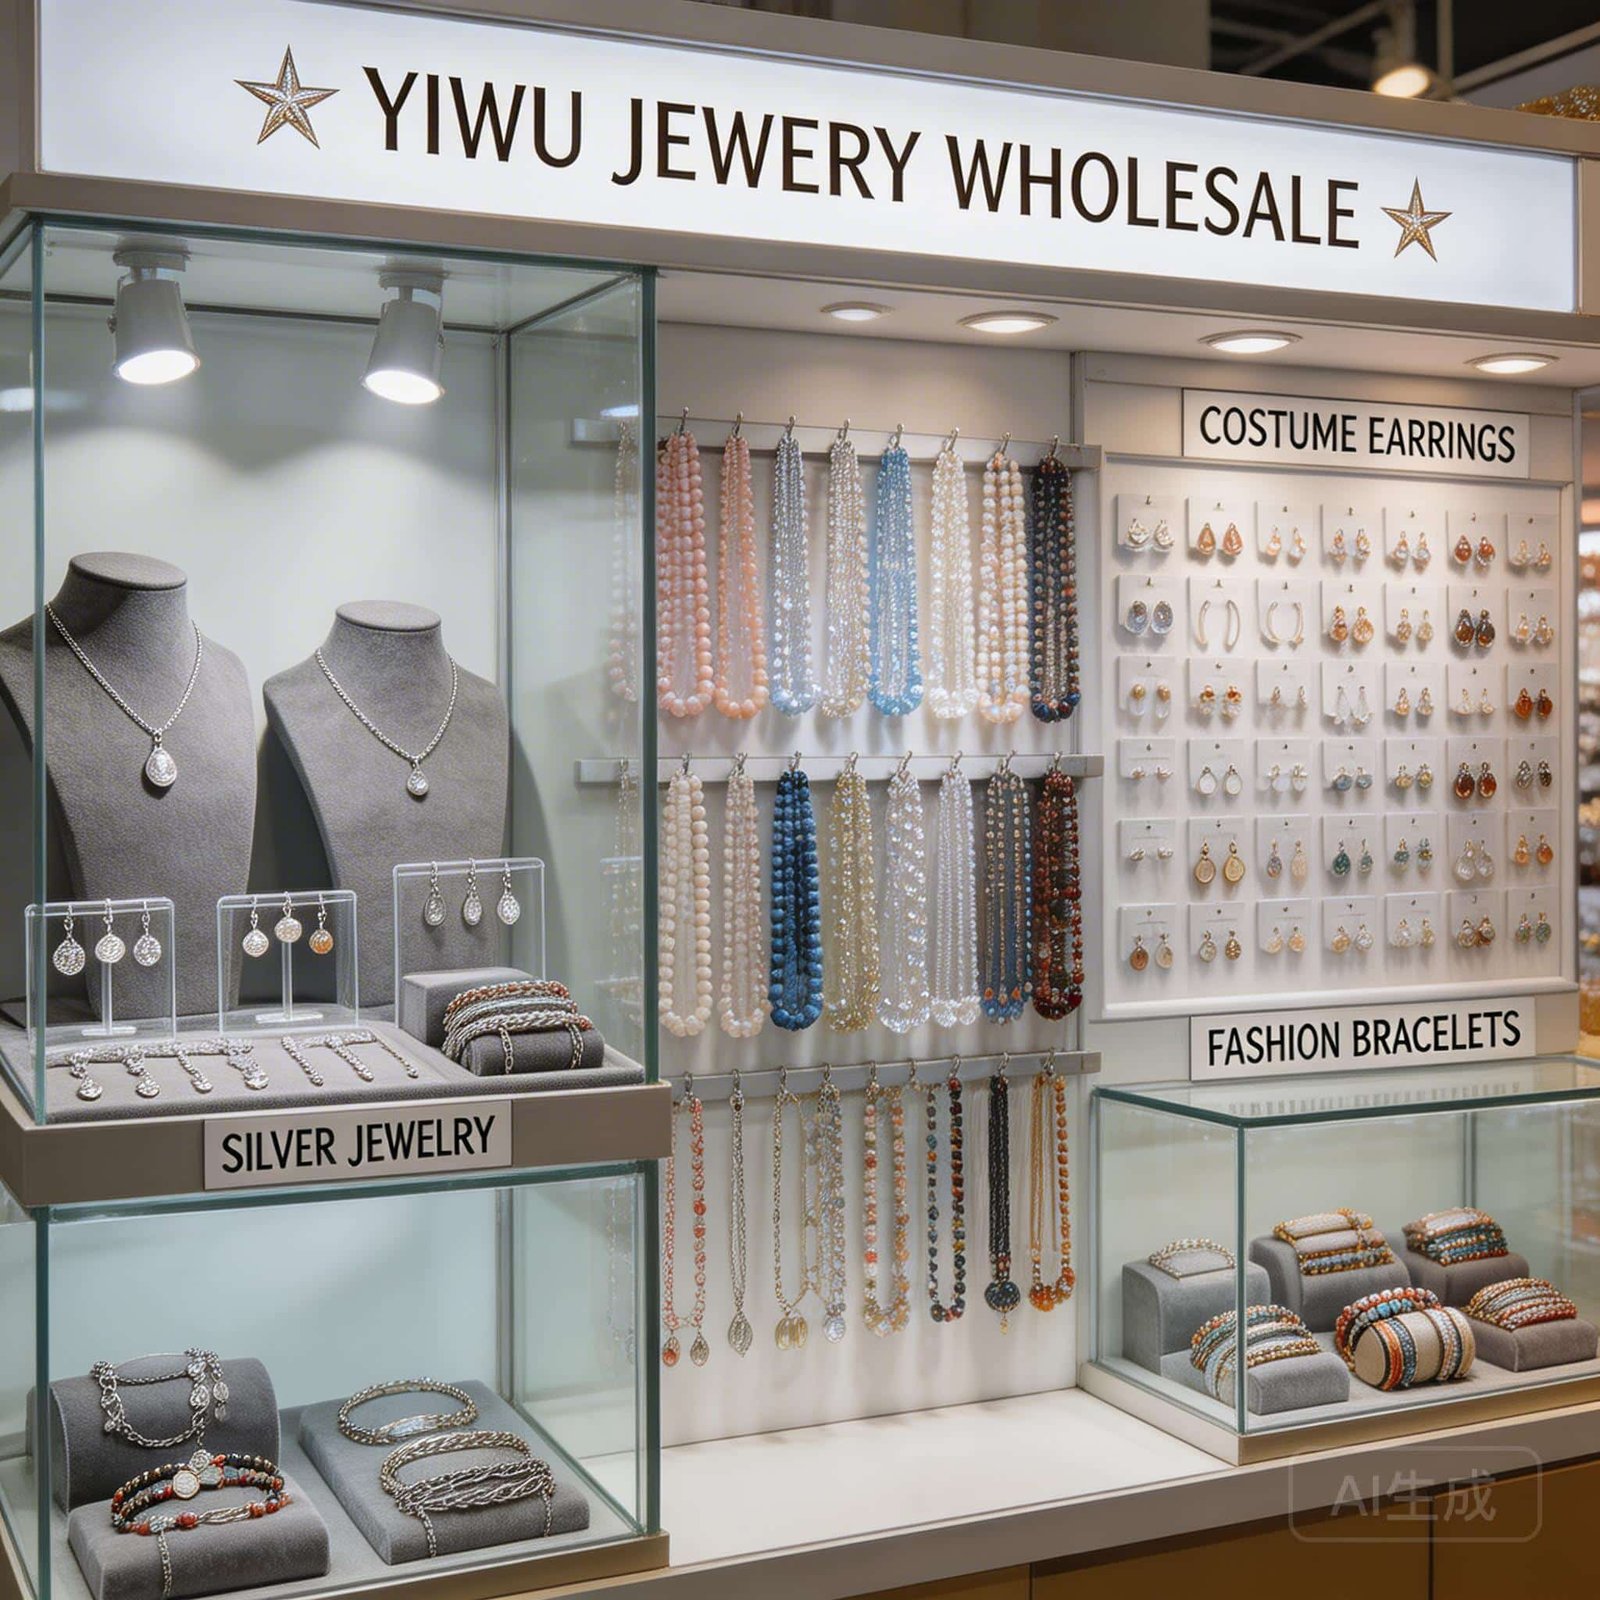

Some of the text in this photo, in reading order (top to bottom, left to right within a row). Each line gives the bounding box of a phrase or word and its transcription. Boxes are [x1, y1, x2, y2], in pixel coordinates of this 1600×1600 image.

[363, 66, 1360, 249] YIWU JEWERY WHOLESALE
[1200, 405, 1516, 464] COSTUME EARRINGS
[1208, 1010, 1521, 1066] FASHION BRACELETS
[221, 1115, 496, 1173] SILVER JEWELRY
